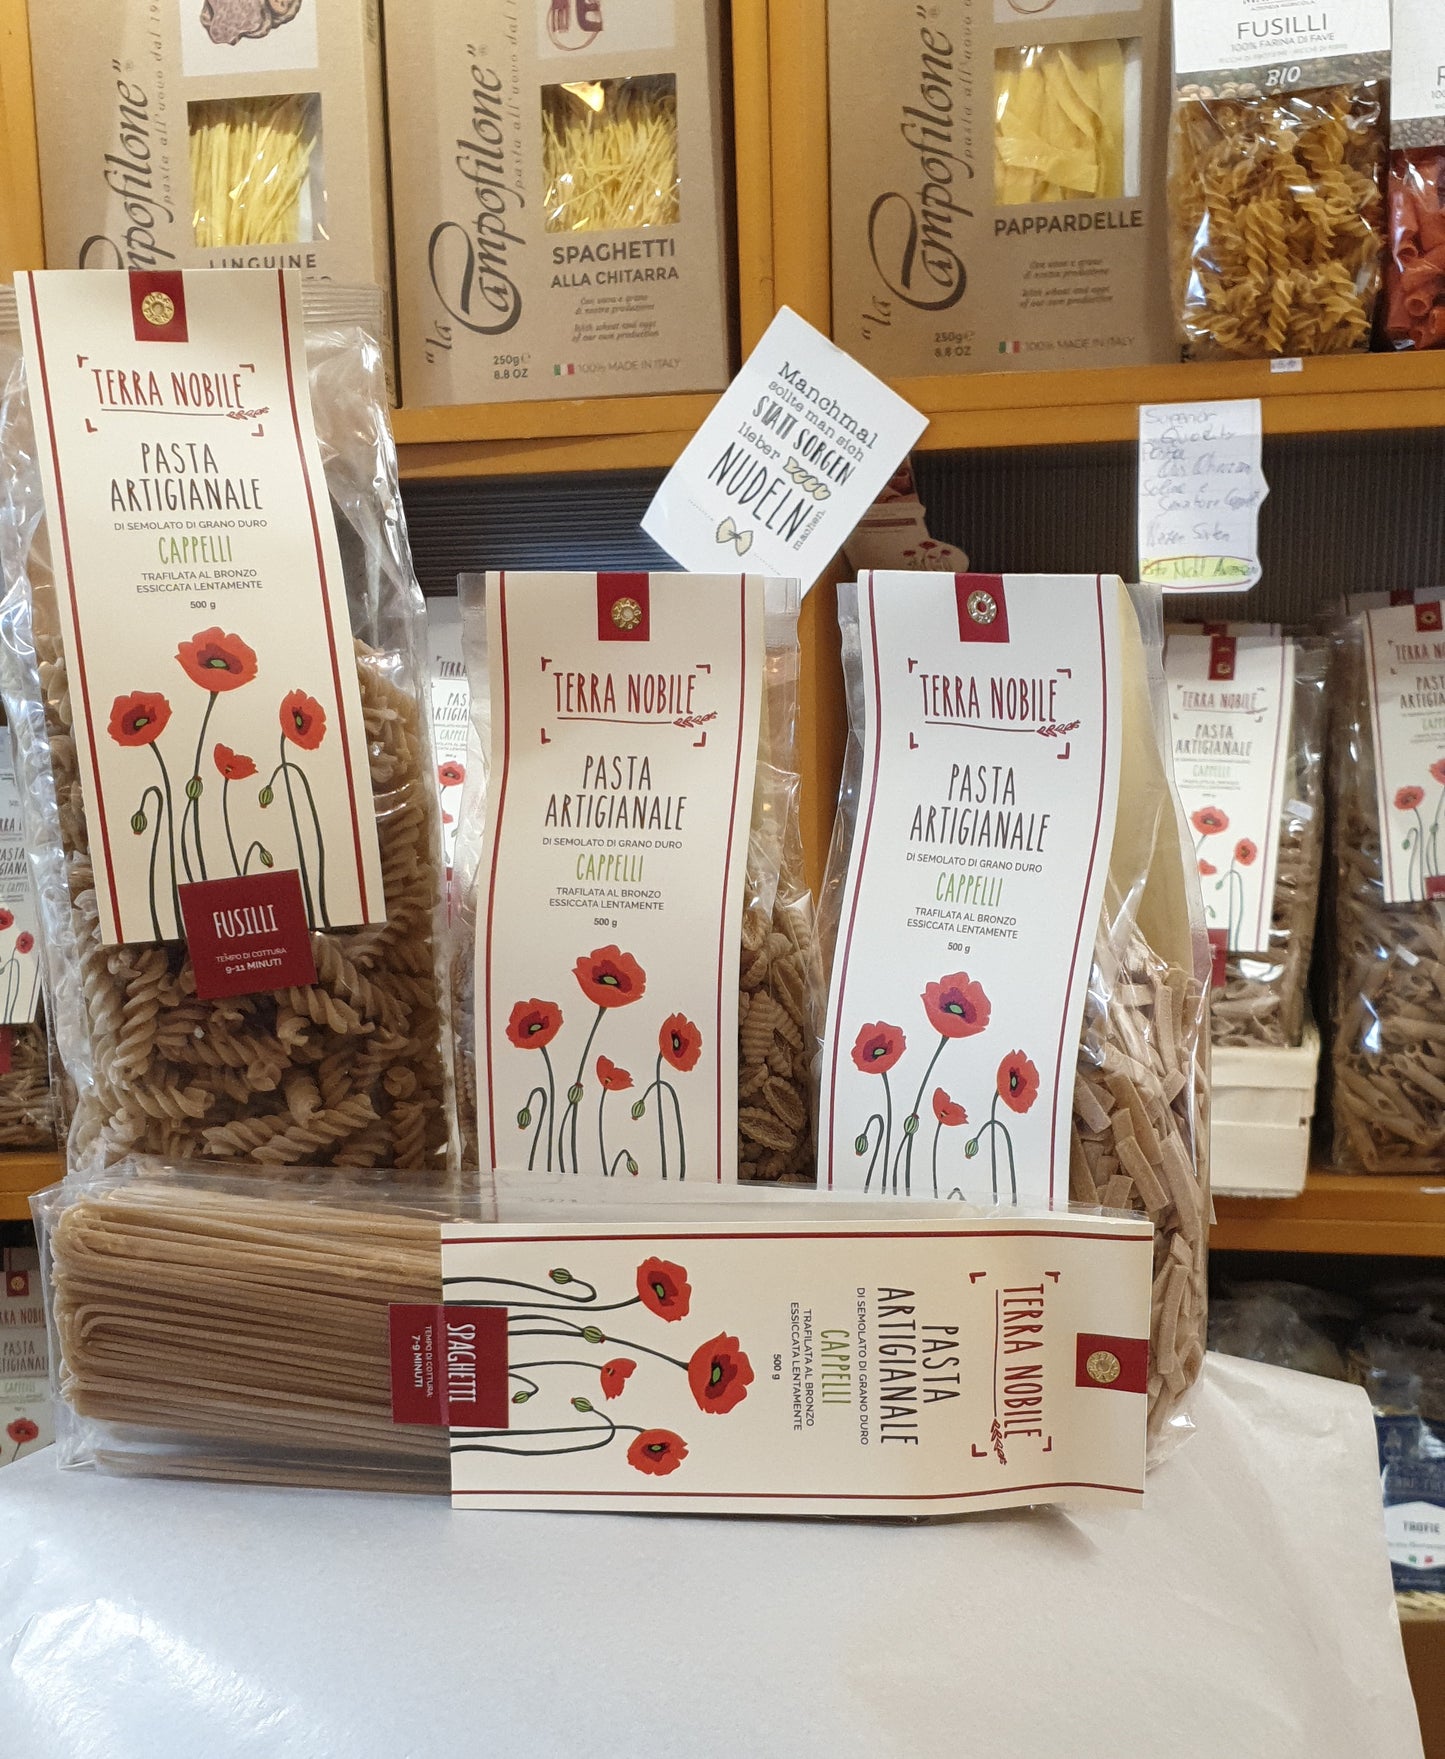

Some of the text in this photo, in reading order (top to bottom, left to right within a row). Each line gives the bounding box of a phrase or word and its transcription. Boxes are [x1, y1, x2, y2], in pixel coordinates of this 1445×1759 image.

[1237, 13, 1327, 40] FUSILLI
[1231, 32, 1335, 52] 100% FARINA DI FAVE
[1265, 66, 1301, 86] BIO
[158, 155, 175, 206] pasta
[994, 209, 1144, 237] PAPPARDELLE
[551, 238, 676, 265] SPAGHETTI
[550, 266, 680, 289] ALLA CHITARRA
[512, 368, 529, 379] OZ
[608, 361, 638, 371] MADE
[640, 360, 651, 370] IN
[654, 359, 680, 369] ITALY
[91, 368, 245, 409] TERRA NOBILE
[778, 361, 878, 450] Manchmal
[768, 381, 865, 463] sollte man sich
[737, 421, 781, 460] lieber
[141, 442, 219, 474] PASTA
[793, 428, 856, 486] SORGEN
[111, 478, 264, 512] ARTIGIANALE
[708, 441, 814, 542] NUDELN
[114, 519, 268, 531] DI SEMOLATO DI GRANO DURO
[158, 535, 233, 565] CAPPELLI
[136, 580, 263, 593] ESSICCATA LENTAMENTE
[141, 569, 257, 581] TRAFILATA AL BRONZO
[190, 601, 216, 610] 500 g
[553, 672, 696, 714] TERRA NOBILE
[919, 674, 1058, 723] TERRA NOBILE
[1175, 739, 1253, 757] ARTIGIANALE
[582, 755, 651, 791] PASTA
[948, 763, 1016, 806] PASTA
[545, 793, 687, 831] ARTIGIANALE
[909, 803, 1051, 853] ARTIGIANALE
[542, 837, 683, 849] DI SEMOLATO DI GRANO DURO
[576, 853, 643, 882] CAPPELLI
[906, 852, 1043, 874] DI SEMOLATO DI GRANO DURO
[557, 887, 661, 898] TRAFILATA AL BRONZO
[935, 871, 1004, 908] CAPPELLI
[549, 898, 664, 911] ESSICCATA LENTAMENTE
[915, 906, 1017, 927] TRAFILATA AL BRONZO
[212, 904, 279, 939] FUSILLI
[594, 917, 618, 928] 500 g
[906, 918, 1019, 940] ESSICCATA LENTAMENTE
[216, 953, 242, 963] TEMPO
[947, 942, 971, 955] 500 g
[225, 958, 282, 974] 9-11 MINUTI
[425, 1325, 433, 1351] TEMPO
[411, 1335, 423, 1388] 7-9 MINUTI
[425, 1352, 433, 1360] DI
[446, 1322, 477, 1403] SPAGHETTI
[773, 1353, 782, 1372] 500
[790, 1302, 803, 1431] ESSICCATA LENTAMENTE
[803, 1309, 814, 1427] TRAFILATA AL BRONZO
[820, 1329, 851, 1404] CAPPELLI
[856, 1287, 869, 1446] DI SEMOLATO DI GRANO DURO
[877, 1287, 919, 1446] ARTIGIANALE
[921, 1325, 960, 1404] PASTA
[1003, 1283, 1044, 1439] TERRA NOBILE
